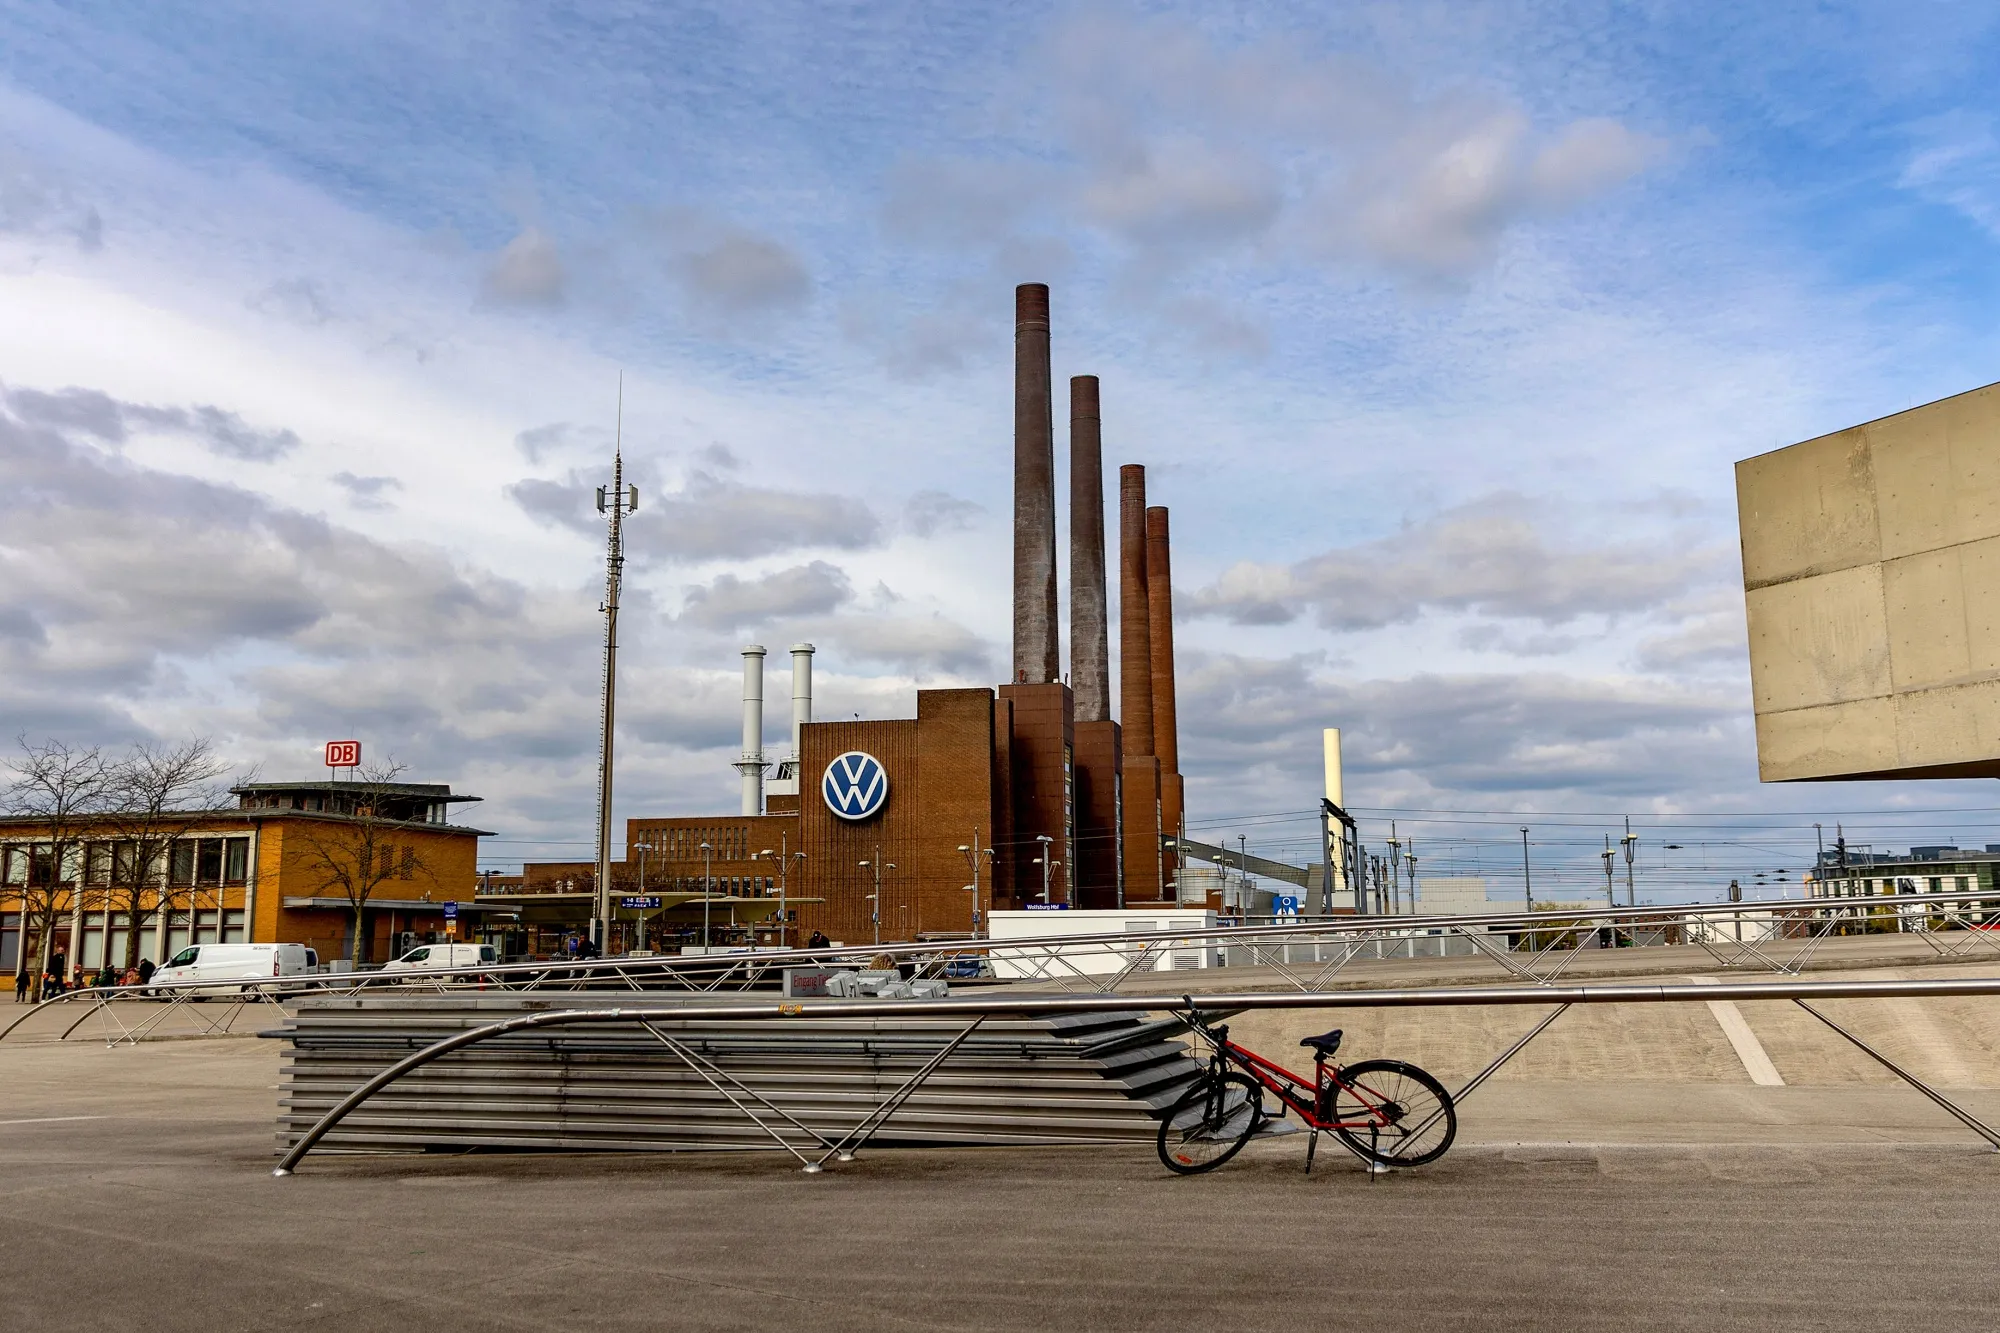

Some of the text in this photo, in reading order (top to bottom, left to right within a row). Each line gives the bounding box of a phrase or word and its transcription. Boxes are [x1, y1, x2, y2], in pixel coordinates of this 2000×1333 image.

[330, 745, 354, 763] DB
[826, 755, 883, 812] VW
[793, 974, 818, 991] Eingang
